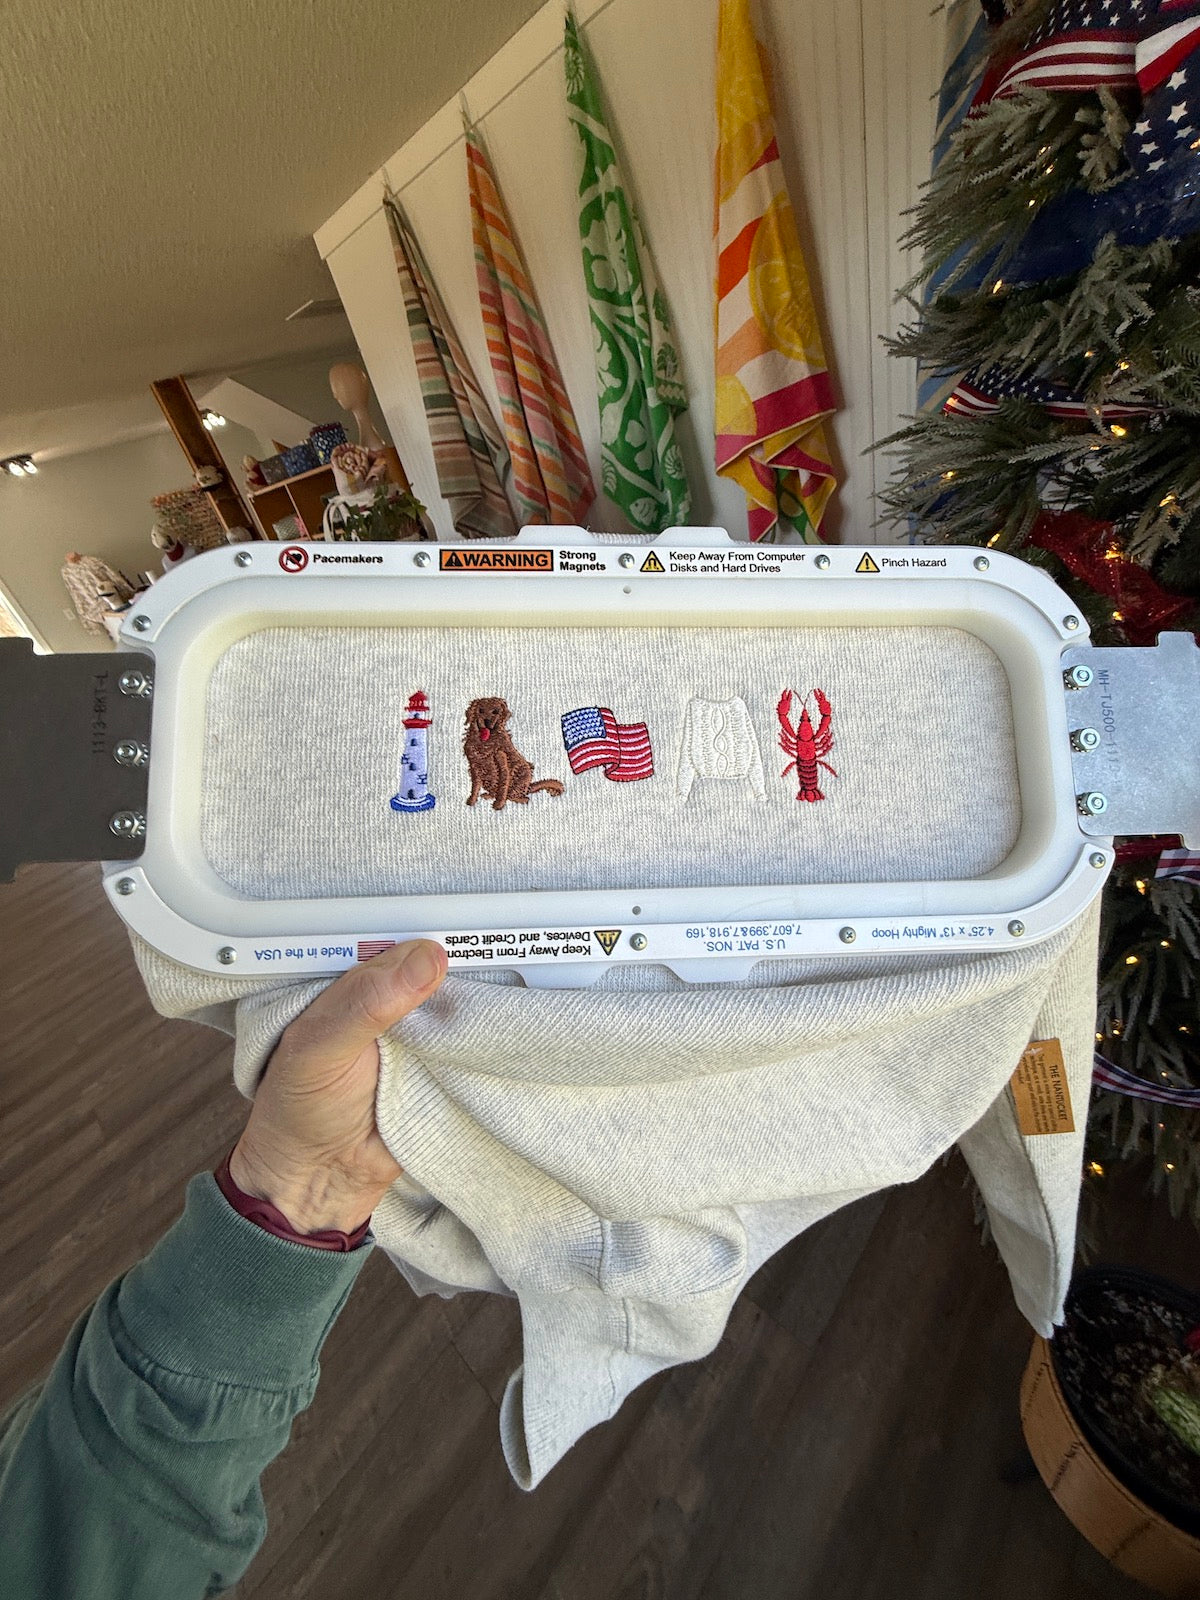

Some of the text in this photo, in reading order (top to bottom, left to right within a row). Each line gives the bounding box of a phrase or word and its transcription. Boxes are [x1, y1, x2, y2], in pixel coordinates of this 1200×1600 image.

[313, 553, 384, 564] Pacemakers
[463, 553, 548, 567] WARNING
[559, 550, 597, 561] Strong
[669, 551, 806, 563] Keep Away From Computer
[881, 558, 947, 567] Pinch Hazard
[559, 561, 607, 572] Magnets
[670, 563, 781, 573] Disks and Hard Drives
[445, 931, 591, 947] Devices, and Credit Cards
[871, 925, 995, 940] 4.25" x 13" Mighty Hoop
[447, 944, 592, 960] Keep Away From Electron
[703, 938, 787, 952] U.S. PAT. NOS.
[254, 946, 354, 961] Made in the USA
[1049, 1064, 1068, 1121] THE NANTUCKET
